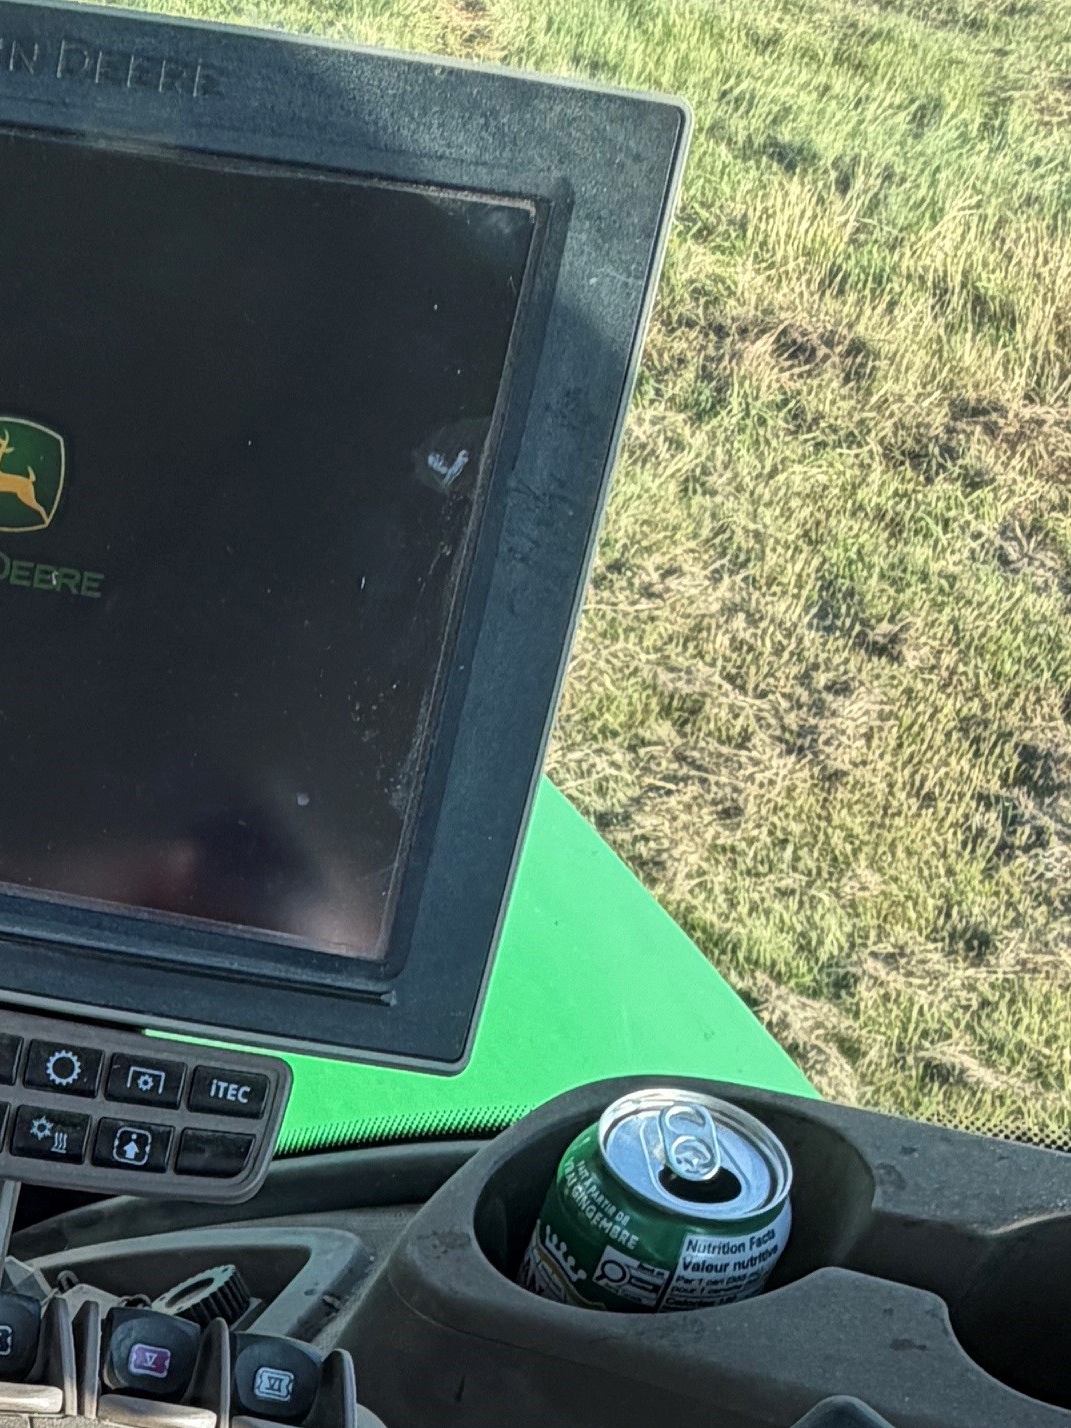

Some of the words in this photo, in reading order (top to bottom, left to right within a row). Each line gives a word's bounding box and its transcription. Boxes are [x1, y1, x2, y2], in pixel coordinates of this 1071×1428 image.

[55, 38, 225, 98] DEERE
[571, 1183, 640, 1250] GINGEMBRE
[685, 1238, 746, 1256] Nutrition
[749, 1228, 776, 1250] Facts
[144, 1353, 159, 1368] V
[264, 1376, 283, 1392] VI
